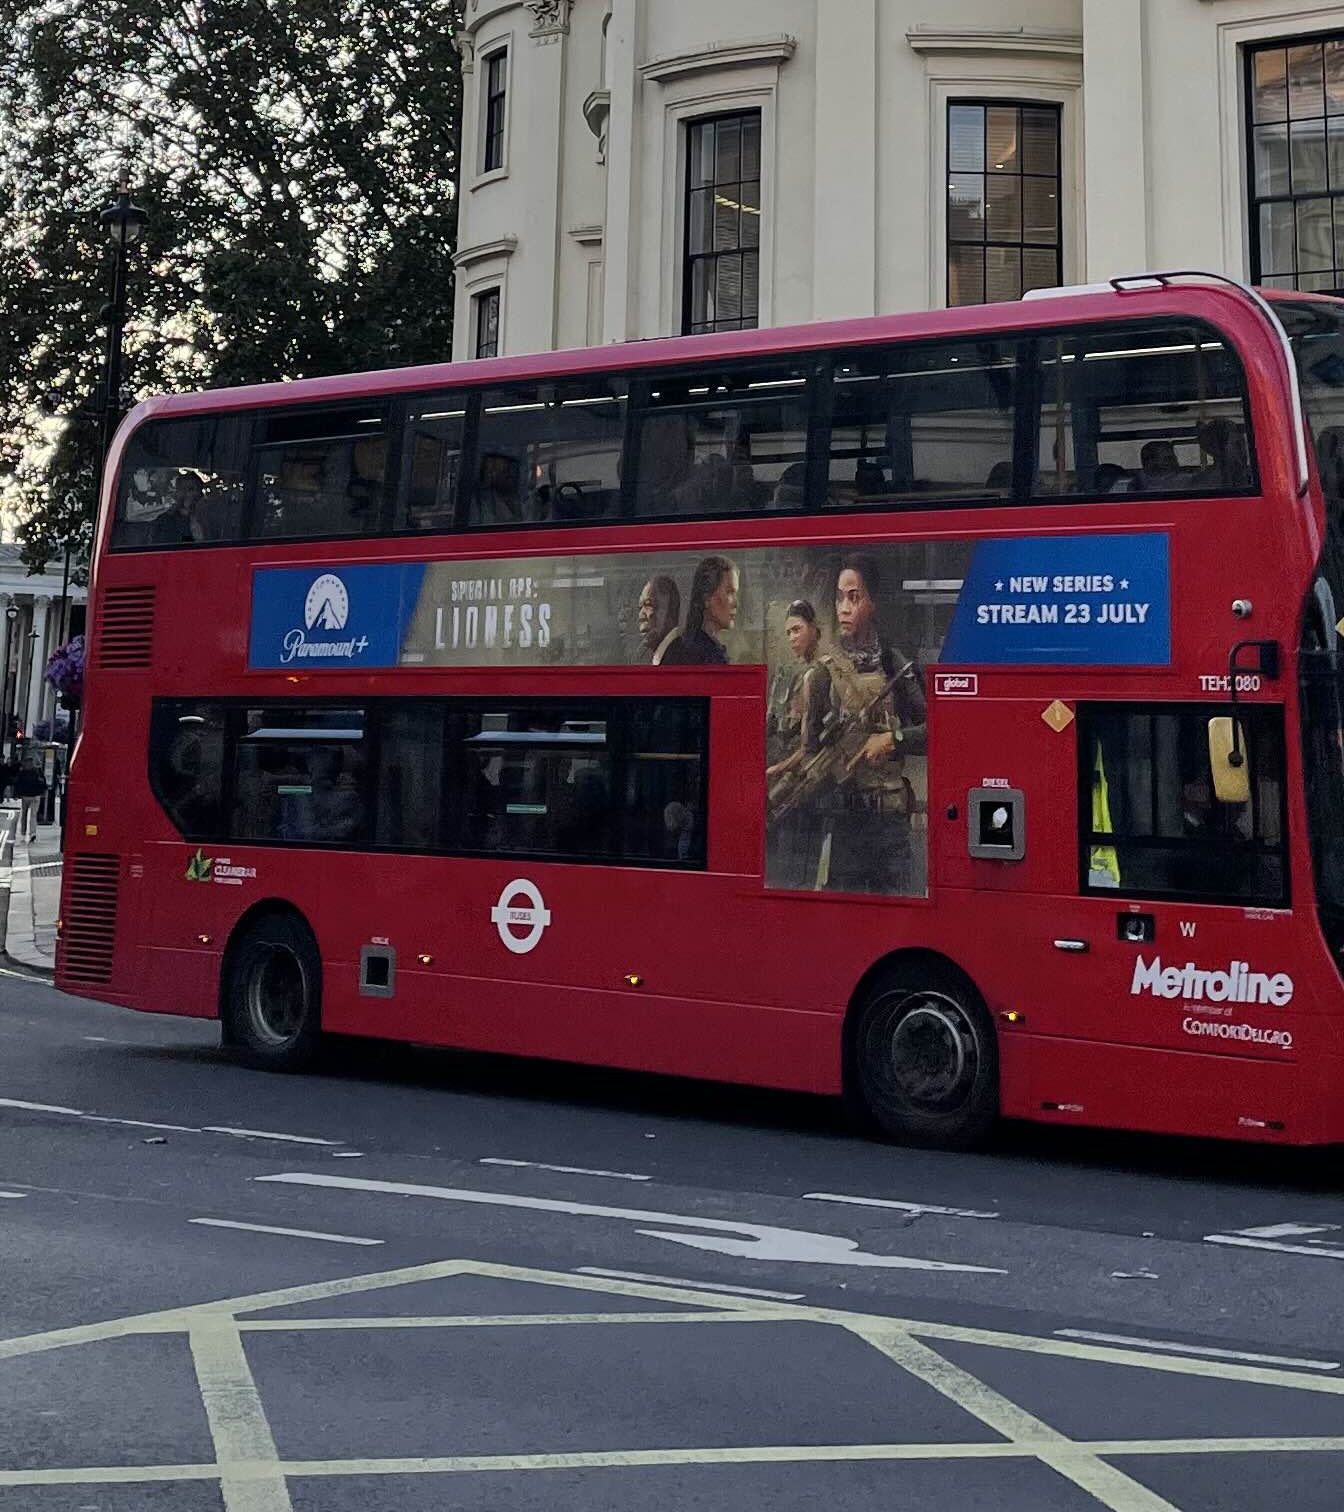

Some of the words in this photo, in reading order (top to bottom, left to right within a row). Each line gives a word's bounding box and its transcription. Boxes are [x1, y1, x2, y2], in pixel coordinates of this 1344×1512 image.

[451, 579, 503, 601] SPECIAL
[1009, 576, 1049, 593] NEW
[1052, 575, 1115, 592] SERIES
[976, 604, 1059, 624] STREAM
[1064, 604, 1091, 624] 23
[1096, 603, 1150, 624] JULY
[435, 603, 551, 650] LIONESS
[944, 677, 969, 691] global
[1179, 921, 1196, 937] W
[1130, 954, 1294, 1006] Metroline
